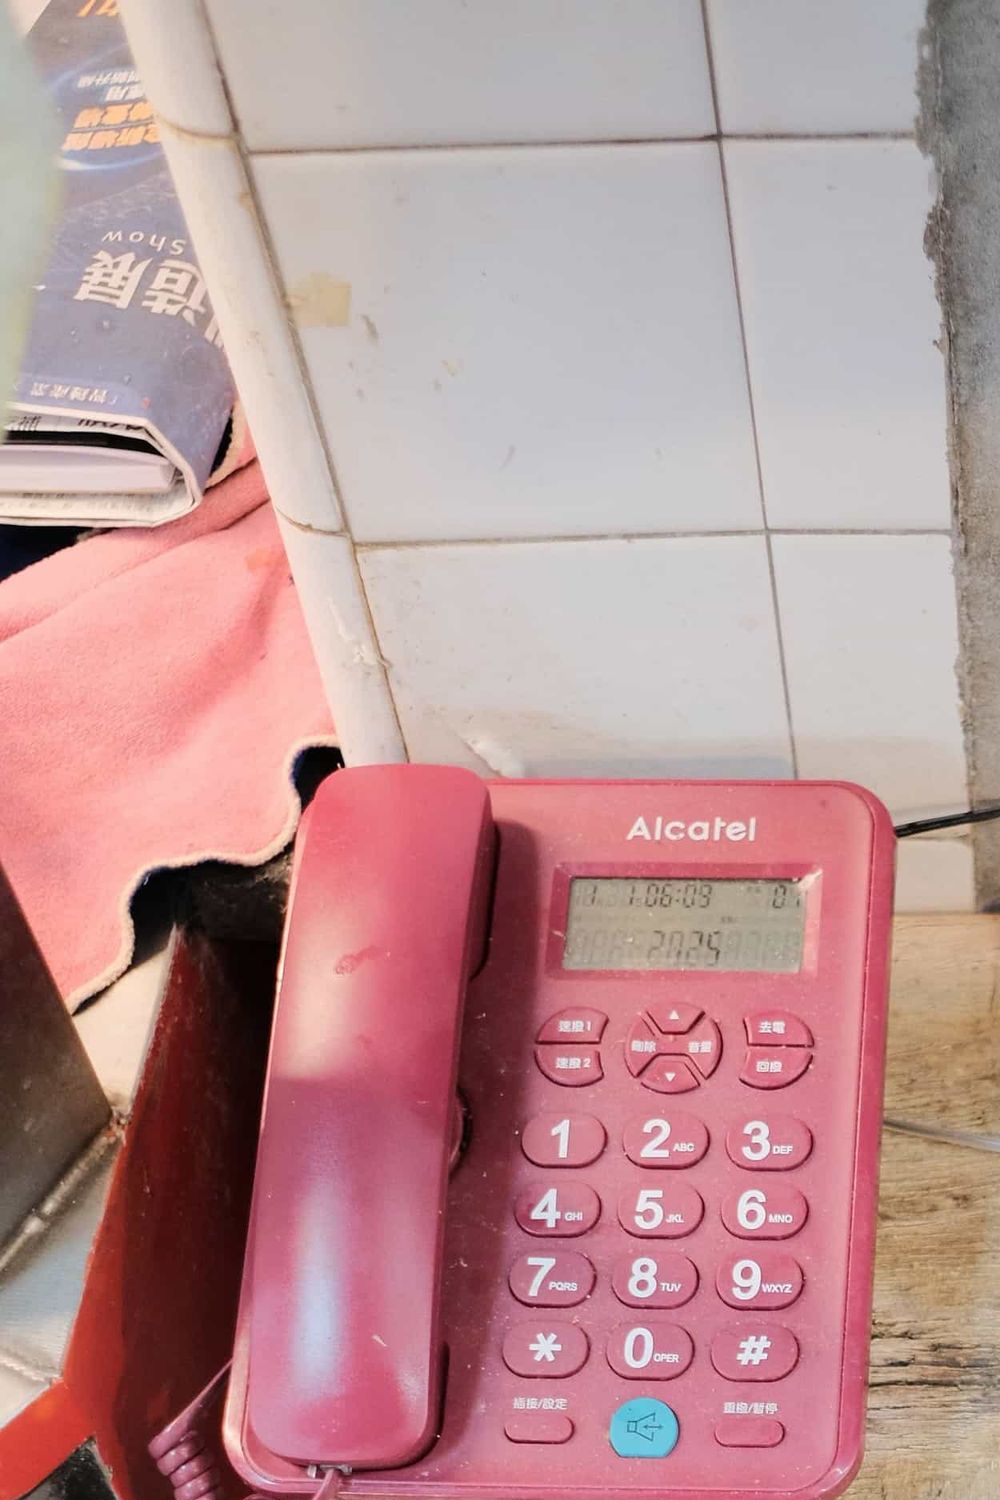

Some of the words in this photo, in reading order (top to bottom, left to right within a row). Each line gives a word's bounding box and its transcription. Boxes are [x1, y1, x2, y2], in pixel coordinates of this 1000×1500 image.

[100, 229, 187, 256] Show
[73, 249, 224, 349] 造展
[626, 816, 756, 841] Alcatel
[646, 930, 721, 966] 2025
[551, 1119, 570, 1158] 1
[640, 1118, 671, 1158] 2
[672, 1142, 695, 1152] ABC
[742, 1120, 771, 1161] 3
[772, 1145, 793, 1155] DEF
[530, 1188, 561, 1228] 4
[564, 1211, 583, 1221] GHI
[634, 1190, 664, 1230] 5
[665, 1214, 684, 1223] JKL
[736, 1190, 766, 1230] 6
[768, 1214, 793, 1224] MNO
[527, 1257, 556, 1297] 7
[548, 1281, 578, 1292] PQRS
[628, 1258, 657, 1298] 8
[660, 1282, 682, 1292] TUV
[732, 1260, 761, 1300] 9
[761, 1283, 792, 1293] WXYZ
[624, 1327, 654, 1369] 0
[653, 1353, 679, 1363] OPER
[736, 1335, 771, 1365] #
